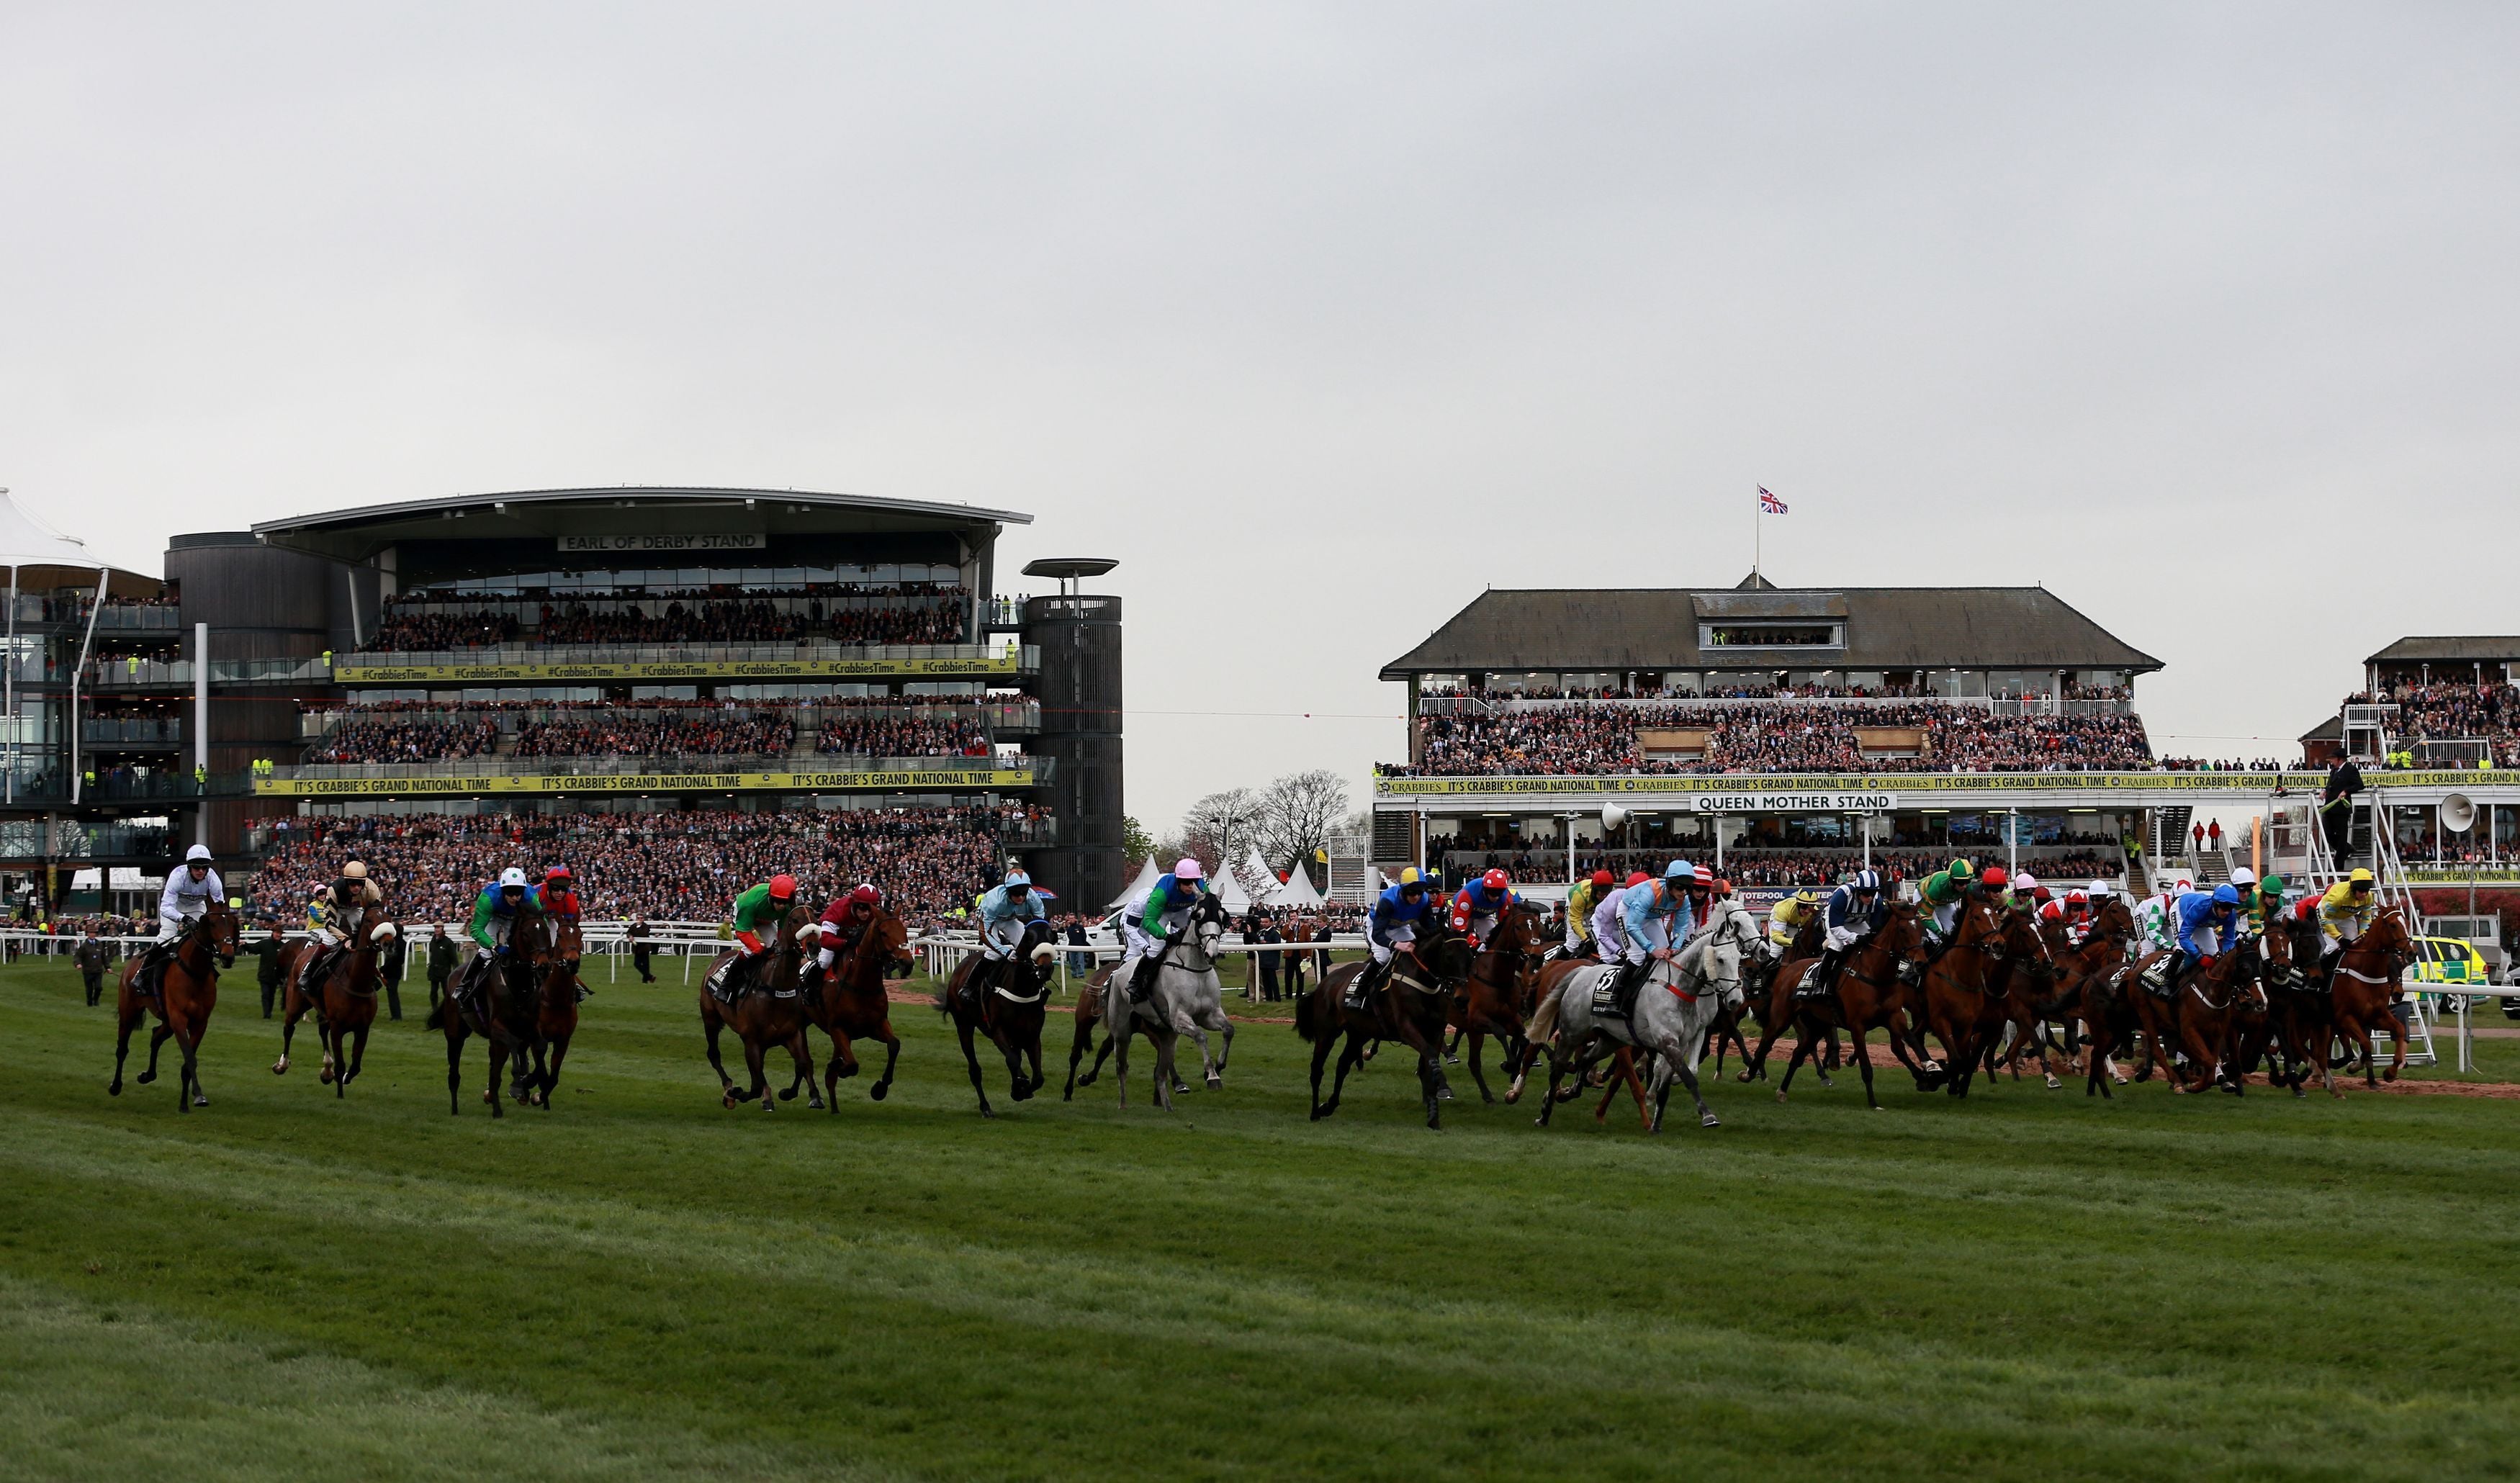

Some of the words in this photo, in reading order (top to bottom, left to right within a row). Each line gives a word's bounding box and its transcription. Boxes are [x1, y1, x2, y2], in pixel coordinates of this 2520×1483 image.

[567, 538, 608, 549] EARL
[614, 536, 636, 549] OF
[643, 536, 696, 549] DERBY
[701, 535, 755, 548] STAND
[455, 667, 520, 679] #CrabbiesTime
[548, 667, 613, 677] #CrabbiesTime
[642, 665, 707, 676] #CrabbiesTime
[735, 664, 801, 675] #CrabbiesTime
[829, 662, 894, 674] #CrabbiesTime
[922, 662, 989, 673] #CrabbiesTime
[362, 669, 427, 680] #CrabbiesTime
[542, 778, 561, 790] IT'S
[564, 777, 617, 789] CRABBIE'S
[620, 777, 657, 788] GRAND
[661, 776, 713, 788] NATIONAL
[716, 775, 741, 787] TIME
[793, 775, 811, 786] IT'S
[815, 774, 868, 786] CRABBIE'S
[871, 773, 909, 785] GRAND
[913, 773, 965, 785] NATIONAL
[968, 772, 993, 784] TIME
[1935, 778, 1951, 788] IT'S
[1954, 777, 1999, 788] CRABBIE'S
[2002, 777, 2035, 787] GRAND
[2038, 777, 2083, 787] NATIONAL
[2084, 777, 2106, 786] TIME
[2174, 777, 2191, 786] IT'S
[2194, 777, 2239, 786] CRABBIE'S
[2241, 777, 2273, 786] GRAND
[2277, 777, 2320, 786] ATIONAL
[2413, 774, 2430, 783] IT'S
[2432, 773, 2478, 783] CRABBIE'S
[2480, 773, 2511, 783] GRAND
[294, 782, 312, 793] IT'S
[317, 781, 368, 792] CRABBIE'S
[372, 780, 409, 791] GRAND
[413, 780, 464, 791] NATIONAL
[467, 779, 490, 790] TIME
[1449, 781, 1464, 791] IT'S
[1467, 781, 1513, 791] CRABBIE'S
[1516, 781, 1548, 791] GRAND
[1550, 780, 1596, 791] NATIONAL
[1598, 780, 1619, 790] TIME
[1693, 780, 1710, 790] IT'S
[1712, 780, 1758, 790] CRABBIE'S
[1760, 780, 1794, 790] GRAND
[1796, 779, 1840, 789] NATIONAL
[1842, 779, 1863, 789] TIME
[1699, 797, 1755, 811] QUEEN
[1763, 796, 1830, 808] MOTHER
[1837, 795, 1889, 808] STAND
[2417, 873, 2451, 881] CRABBIE'S
[2150, 954, 2172, 973] 34
